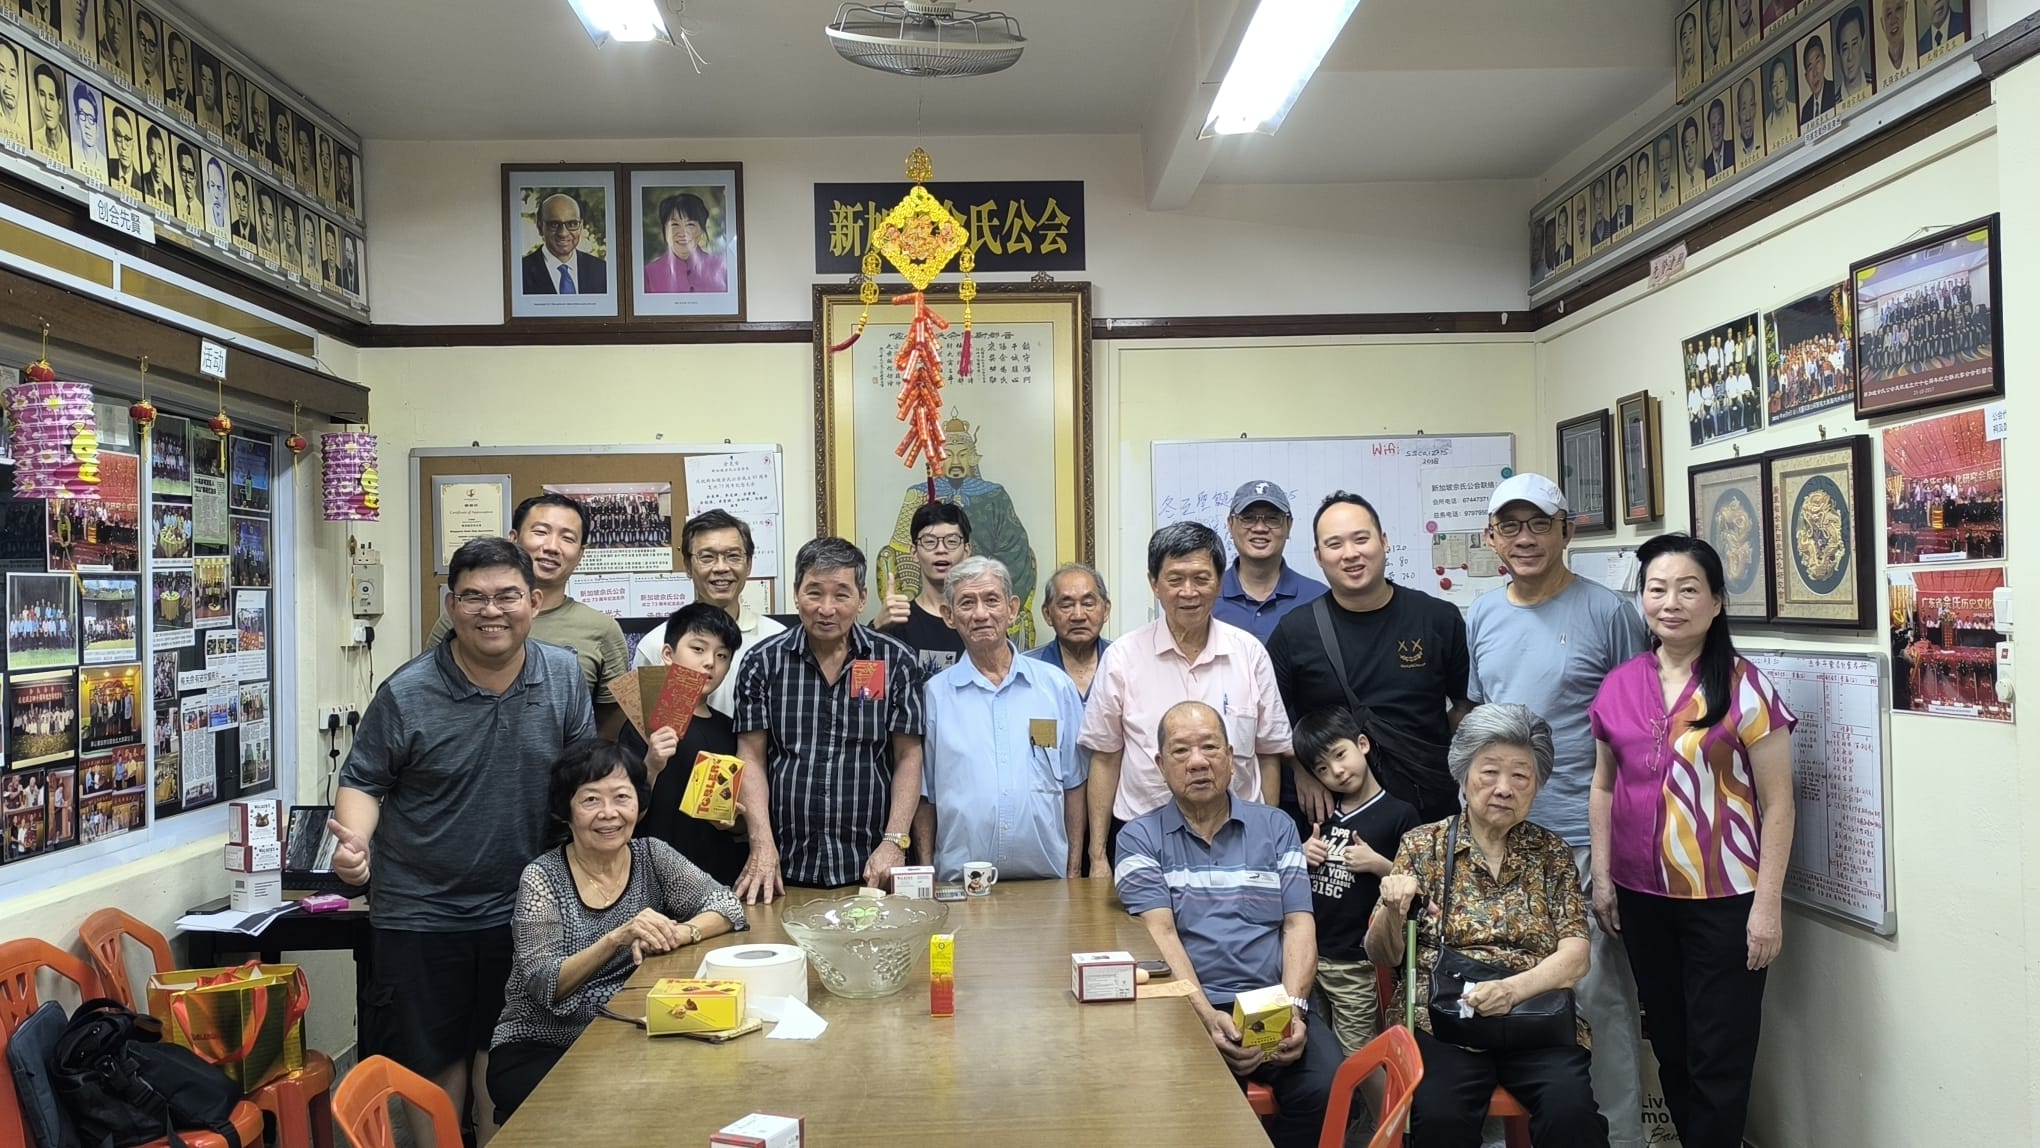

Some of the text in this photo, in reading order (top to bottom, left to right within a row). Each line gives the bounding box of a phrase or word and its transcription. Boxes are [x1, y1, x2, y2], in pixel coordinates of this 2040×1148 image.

[97, 199, 142, 235] 创会先賢
[203, 345, 224, 373] 活动
[1331, 826, 1350, 838] DPR
[1328, 867, 1355, 883] YORK
[1312, 880, 1343, 899] 315C
[1642, 1093, 1663, 1108] Liv
[1641, 1111, 1669, 1123] mo
